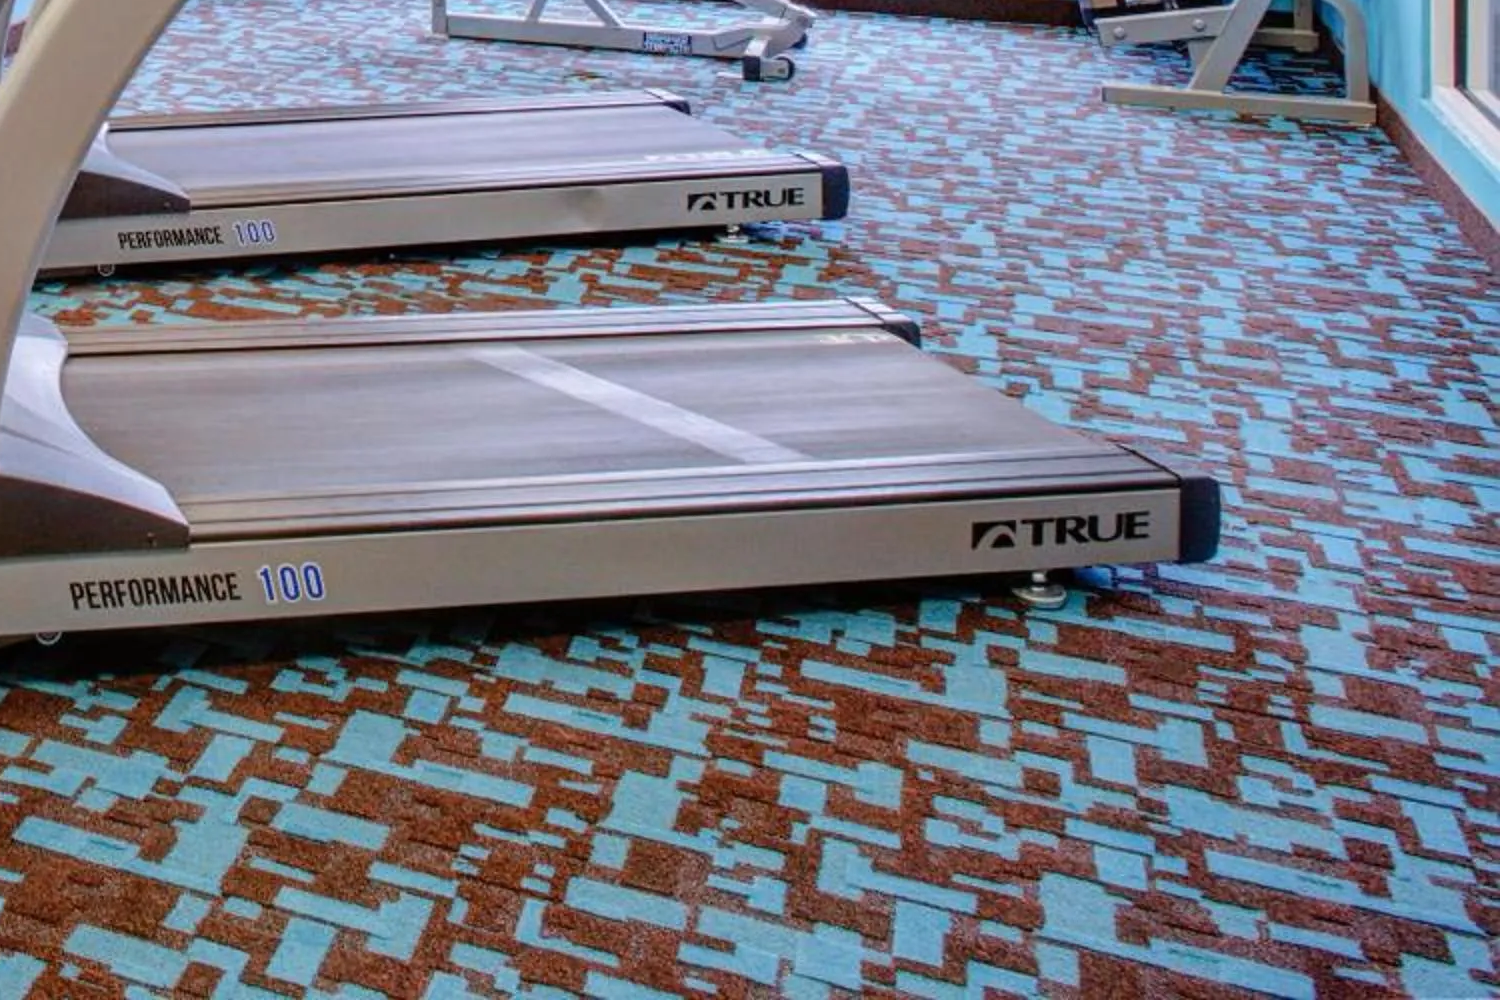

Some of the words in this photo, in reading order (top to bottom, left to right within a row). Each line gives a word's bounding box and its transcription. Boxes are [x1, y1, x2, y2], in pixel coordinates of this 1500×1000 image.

[720, 187, 804, 209] TRUE
[117, 226, 224, 249] PERFORMANCE
[233, 219, 276, 246] 100
[1021, 511, 1150, 546] TRUE
[69, 572, 241, 610] PERFORMANCE
[258, 562, 326, 602] 100
